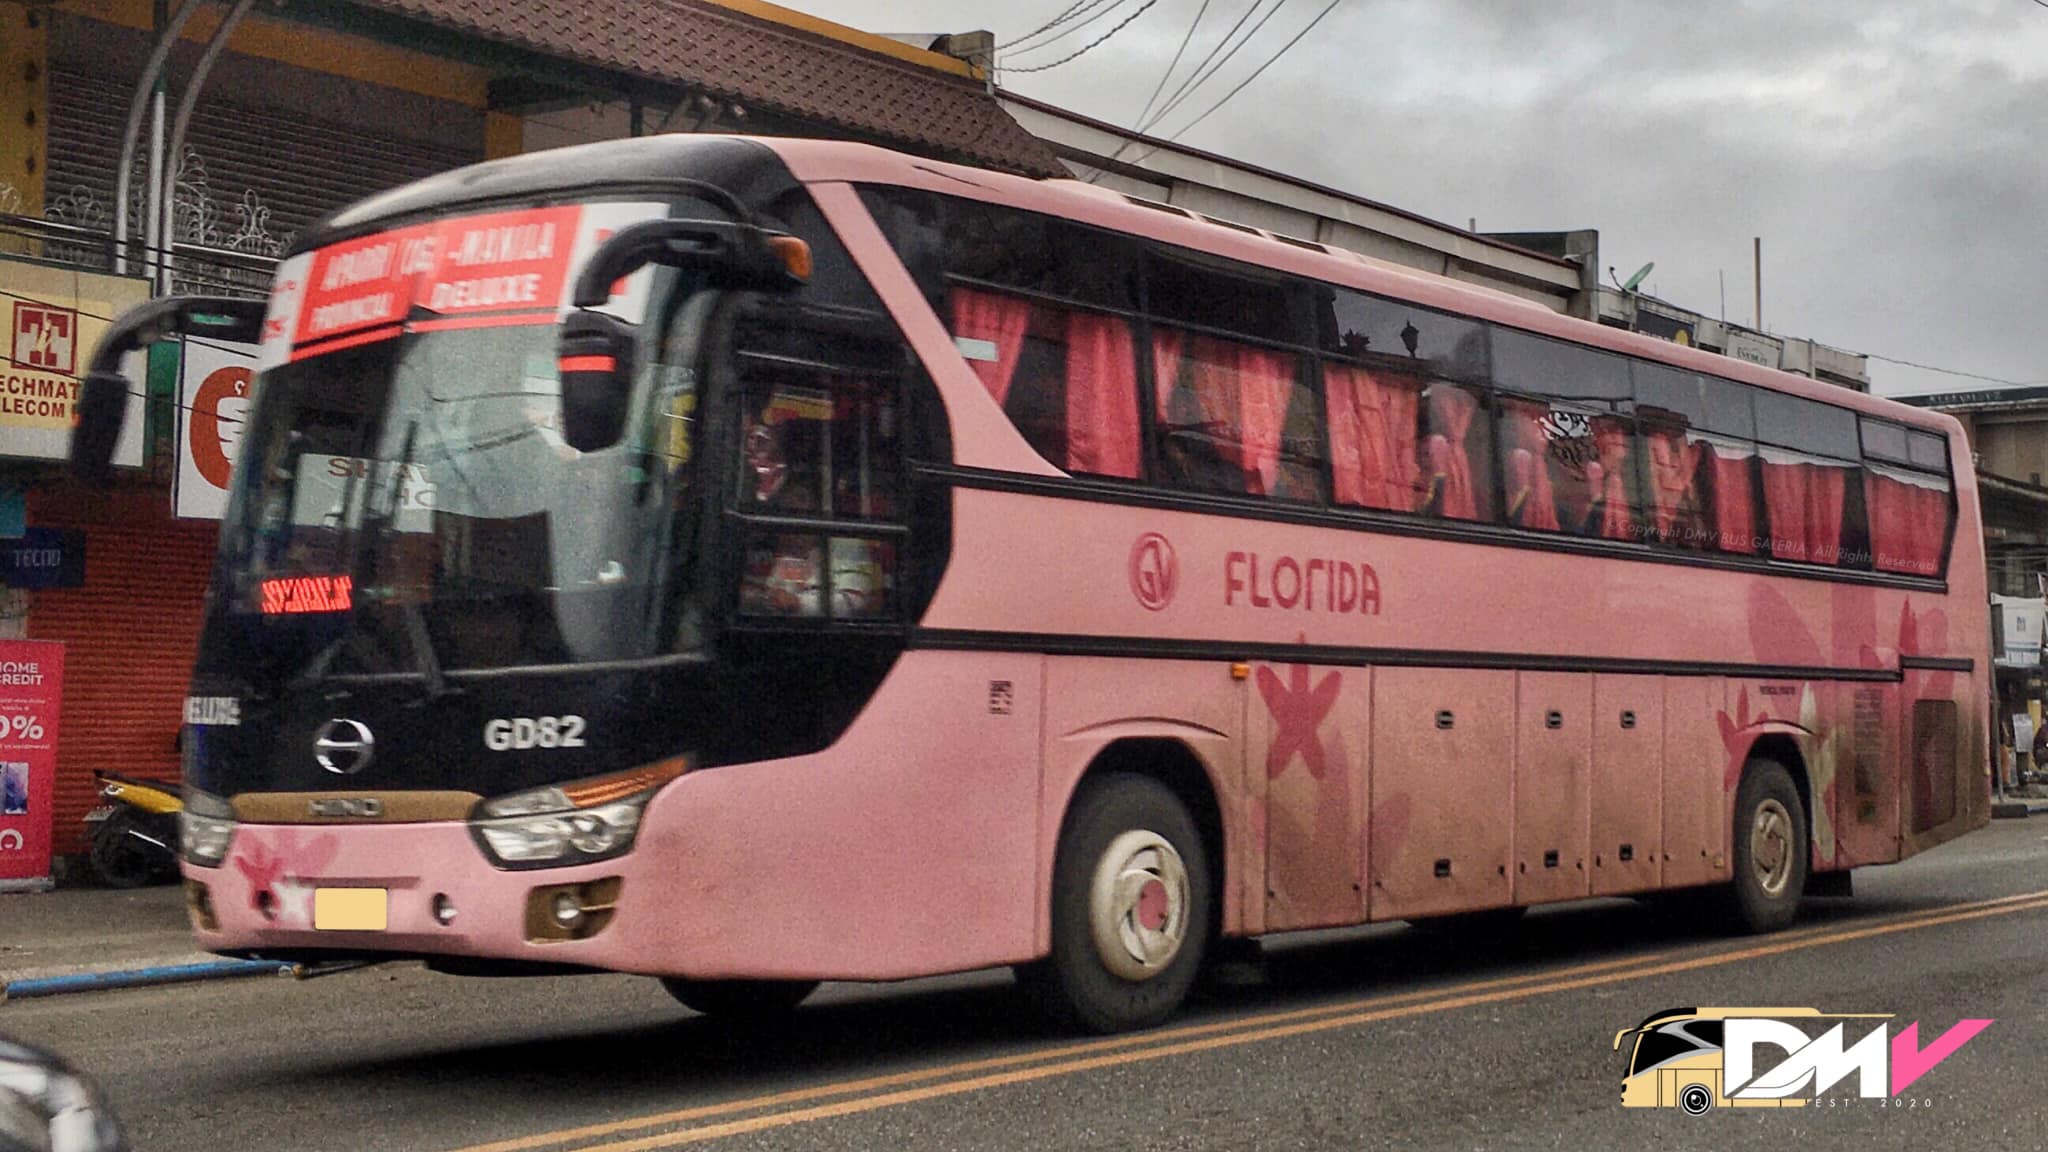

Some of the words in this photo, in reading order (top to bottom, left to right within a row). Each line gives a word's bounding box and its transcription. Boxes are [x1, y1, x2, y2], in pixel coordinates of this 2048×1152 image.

[1225, 551, 1381, 615] FLORIDA
[0, 661, 39, 674] OME
[0, 673, 44, 686] REDIT
[484, 715, 586, 751] GD82
